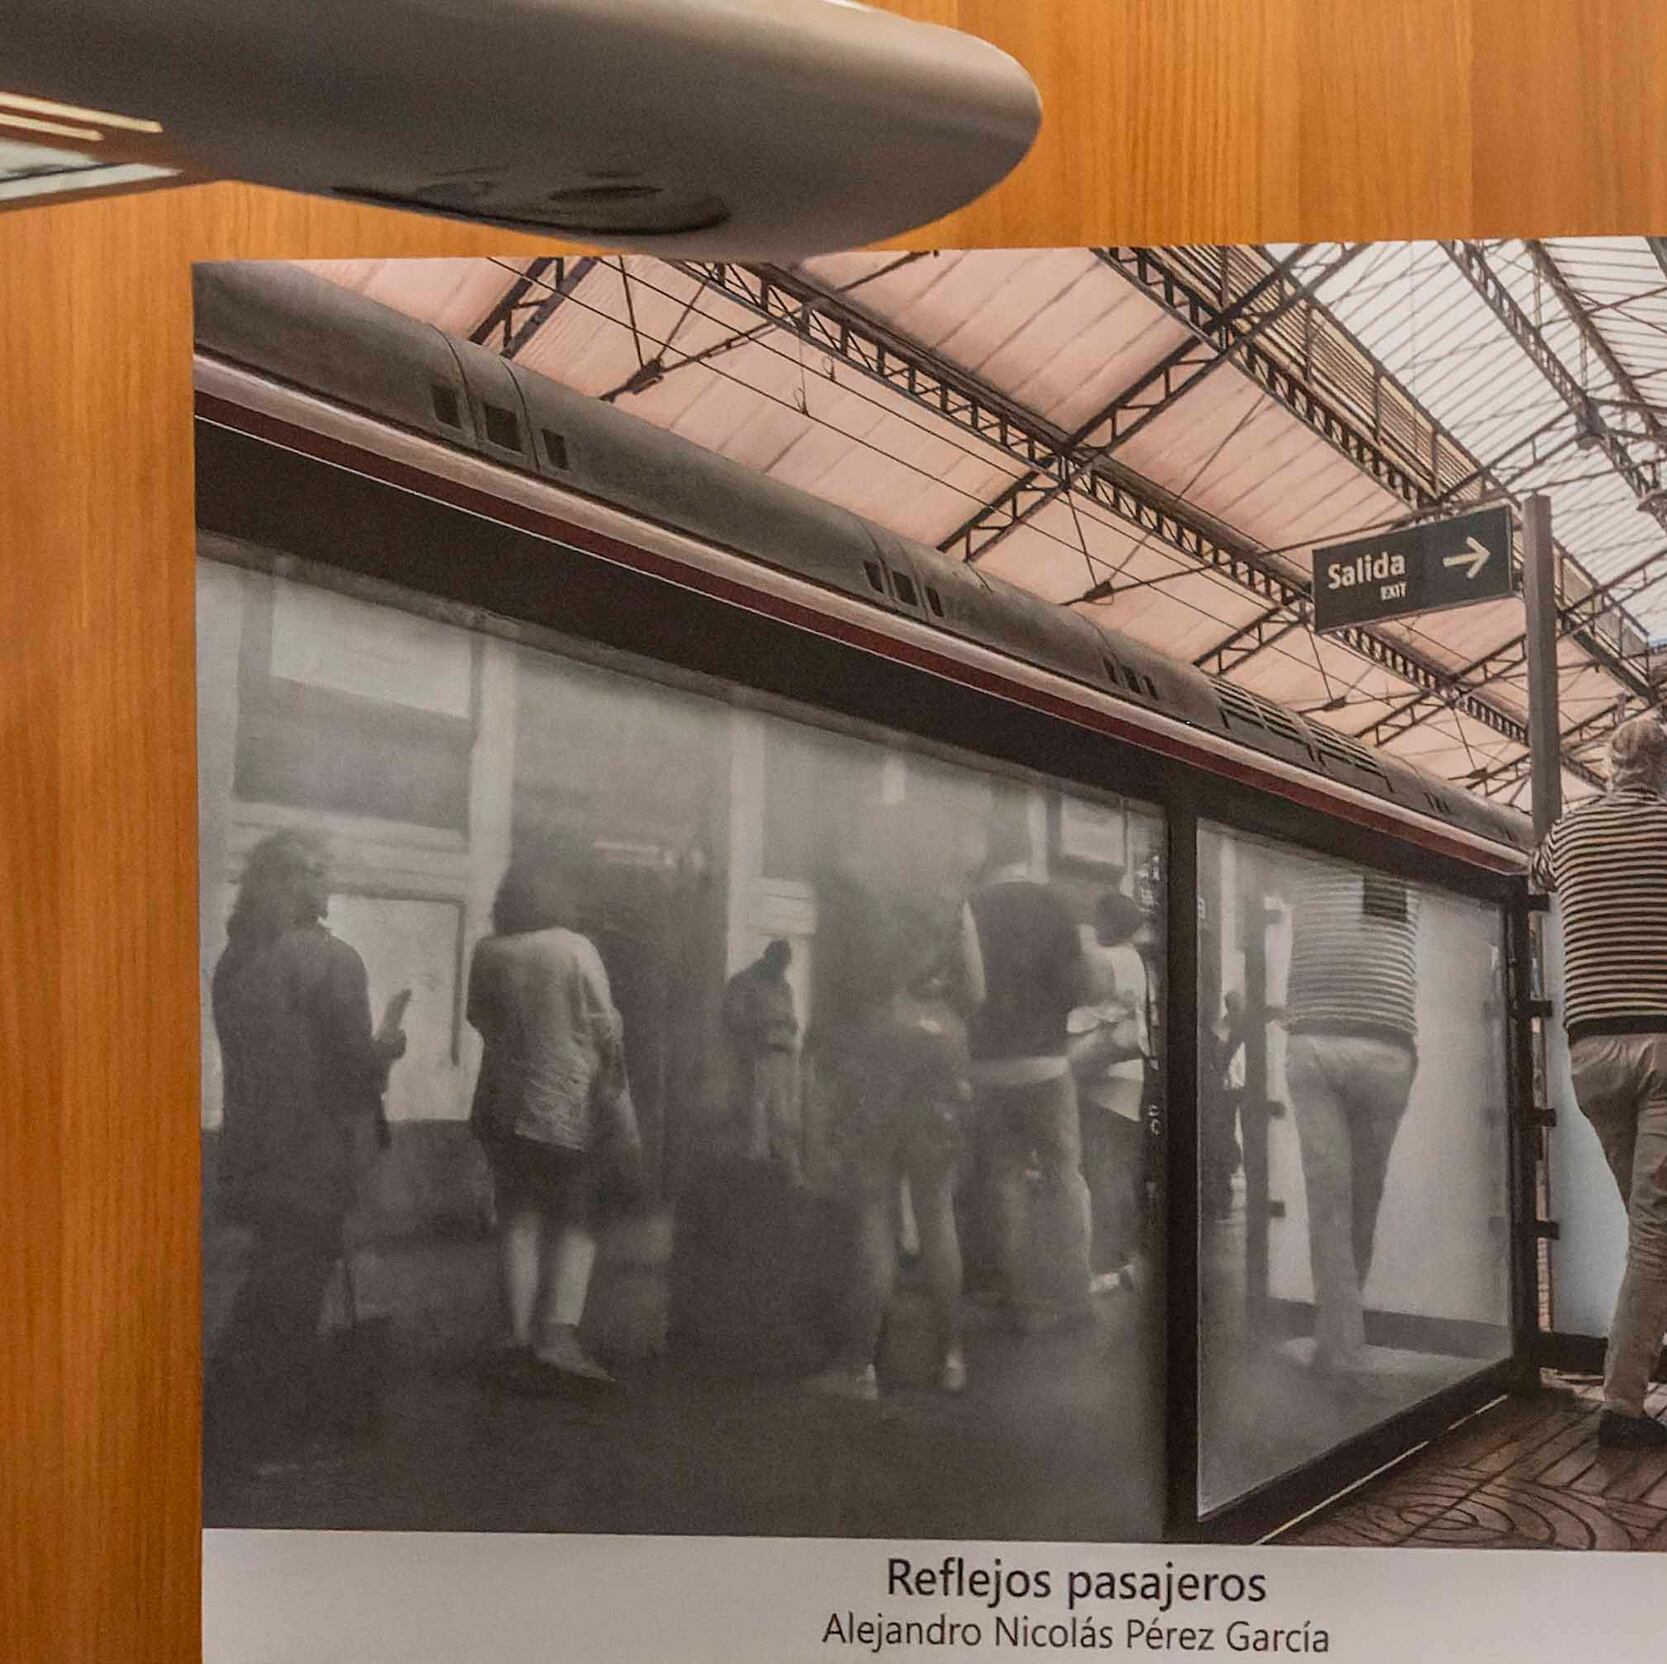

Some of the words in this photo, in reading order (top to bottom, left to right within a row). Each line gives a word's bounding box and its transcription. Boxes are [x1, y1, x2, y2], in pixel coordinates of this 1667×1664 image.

[1328, 552, 1406, 590] Salida
[1380, 582, 1407, 601] EXIT
[888, 1555, 1052, 1609] Reflejos
[1068, 1561, 1267, 1612] pasajeros
[821, 1611, 982, 1655] Alejandro
[995, 1615, 1114, 1650] Nicolás
[1126, 1617, 1216, 1651] Pérez
[1224, 1620, 1330, 1655] García
